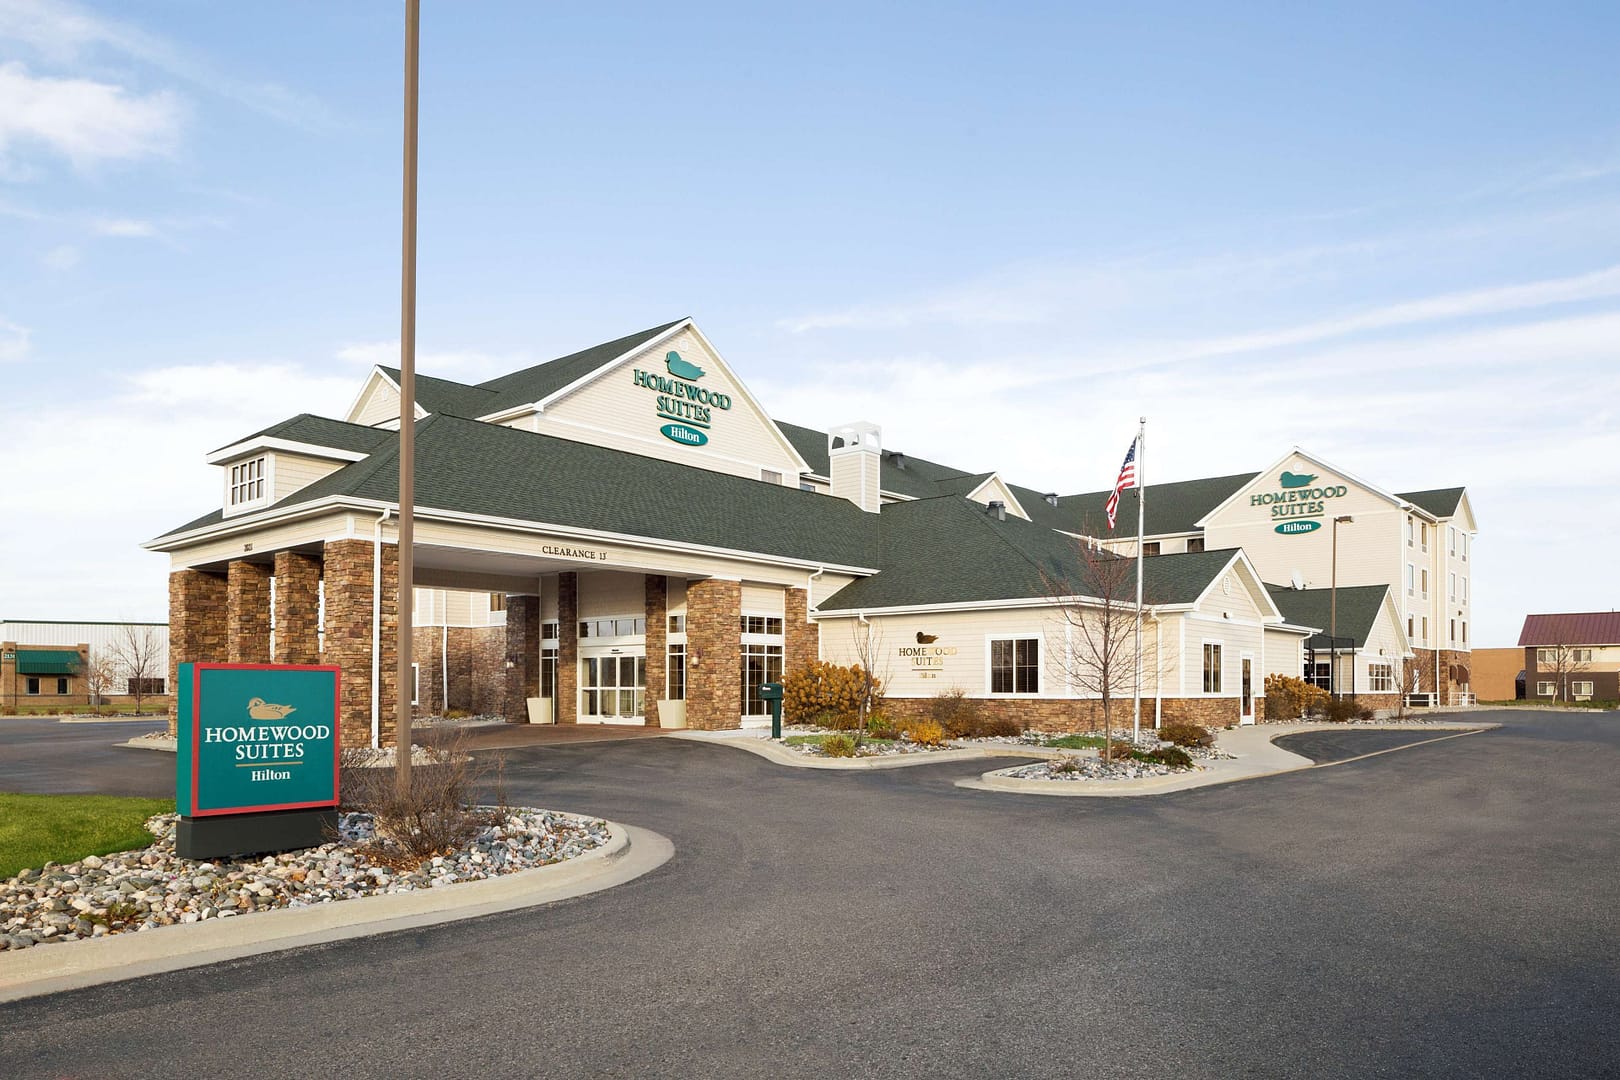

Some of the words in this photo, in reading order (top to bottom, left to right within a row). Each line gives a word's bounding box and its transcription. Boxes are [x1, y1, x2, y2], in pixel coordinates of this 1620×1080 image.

[633, 369, 732, 410] HOMEWOOD
[656, 395, 711, 422] SUITES
[671, 426, 700, 443] Hilton
[1250, 485, 1347, 506] HOMEWOOD
[1271, 501, 1324, 517] SUITES
[1283, 522, 1312, 533] Hilton
[542, 545, 596, 559] CLEARANCE
[204, 725, 330, 743] HOMEWOOD
[235, 742, 304, 760] SUITES
[251, 768, 291, 781] Hilton
